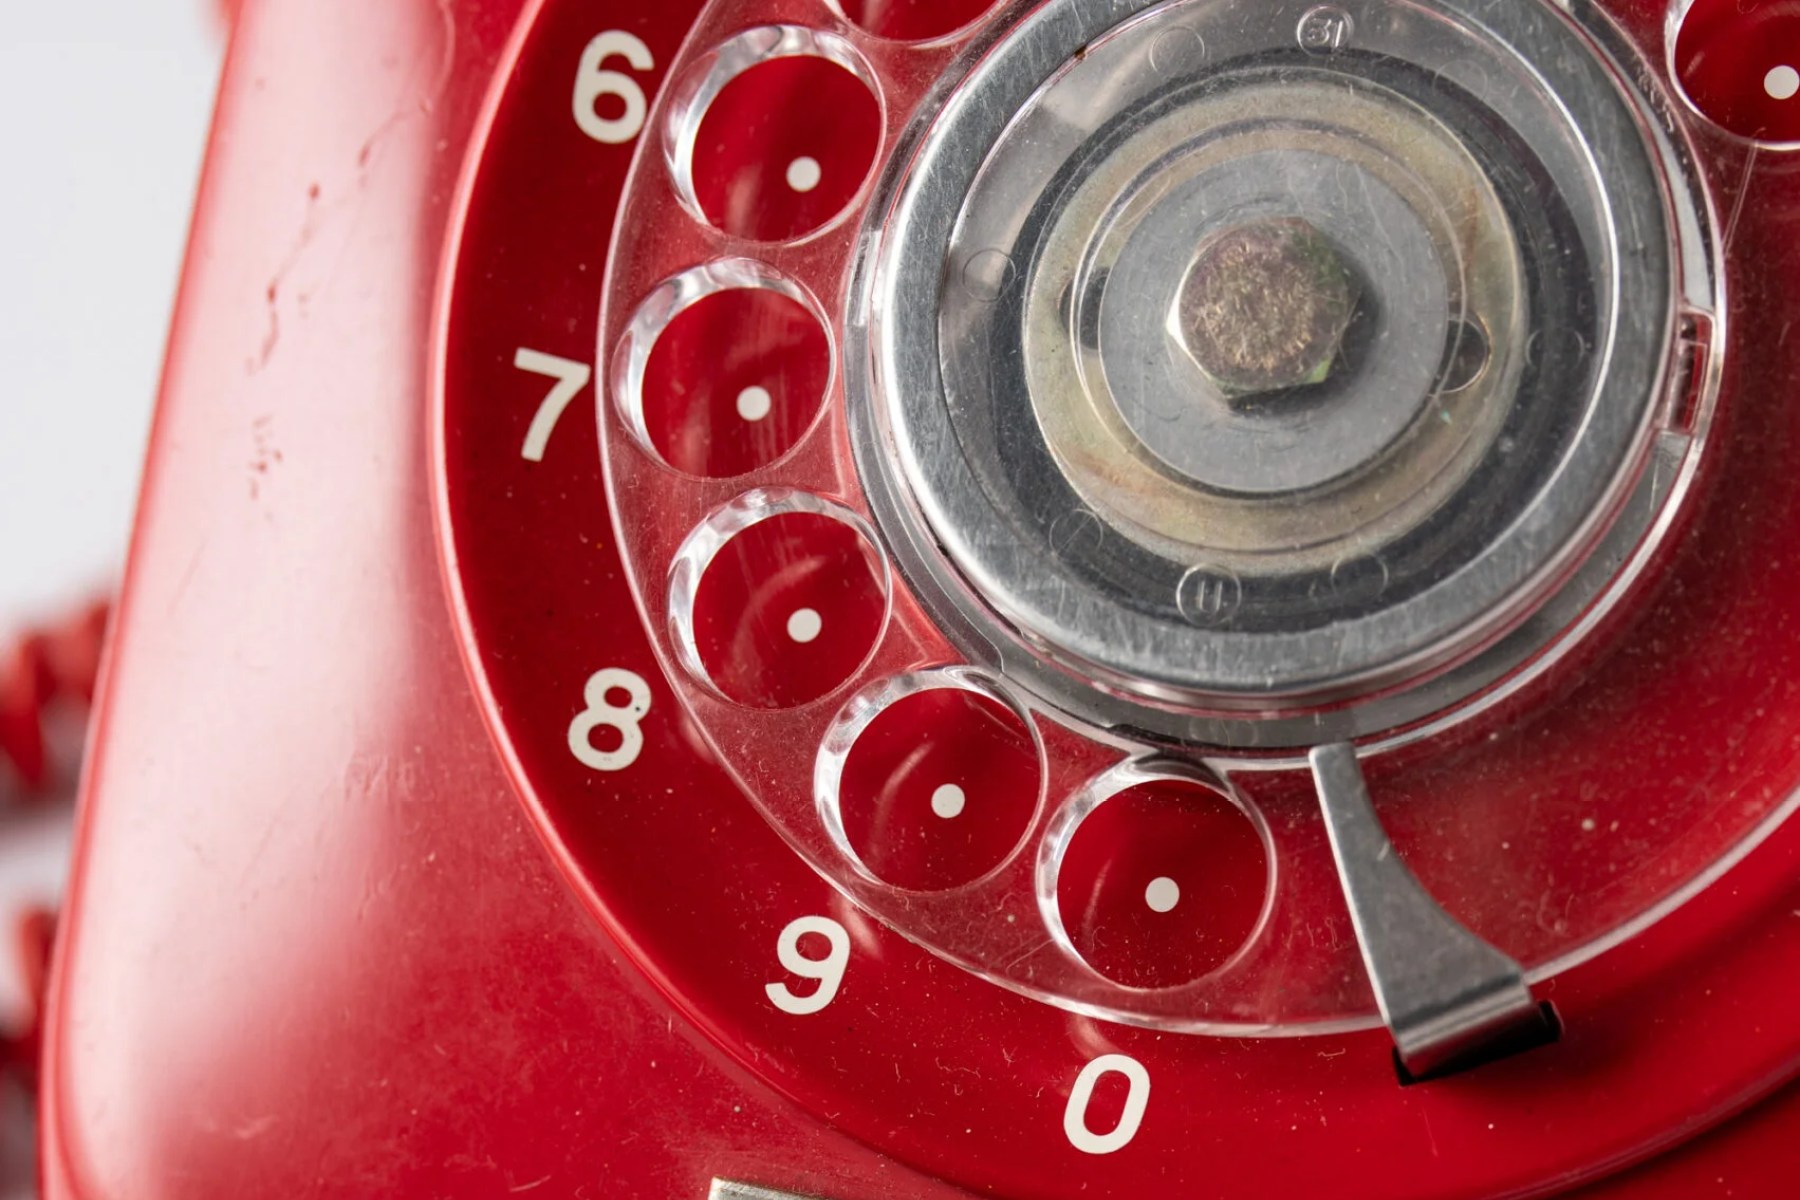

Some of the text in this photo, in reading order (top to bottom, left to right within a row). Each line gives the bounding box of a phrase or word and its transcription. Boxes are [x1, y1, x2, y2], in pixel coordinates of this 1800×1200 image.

[573, 30, 653, 142] 6
[514, 348, 590, 461] 7
[568, 668, 651, 770] 8
[765, 915, 850, 1015] 9
